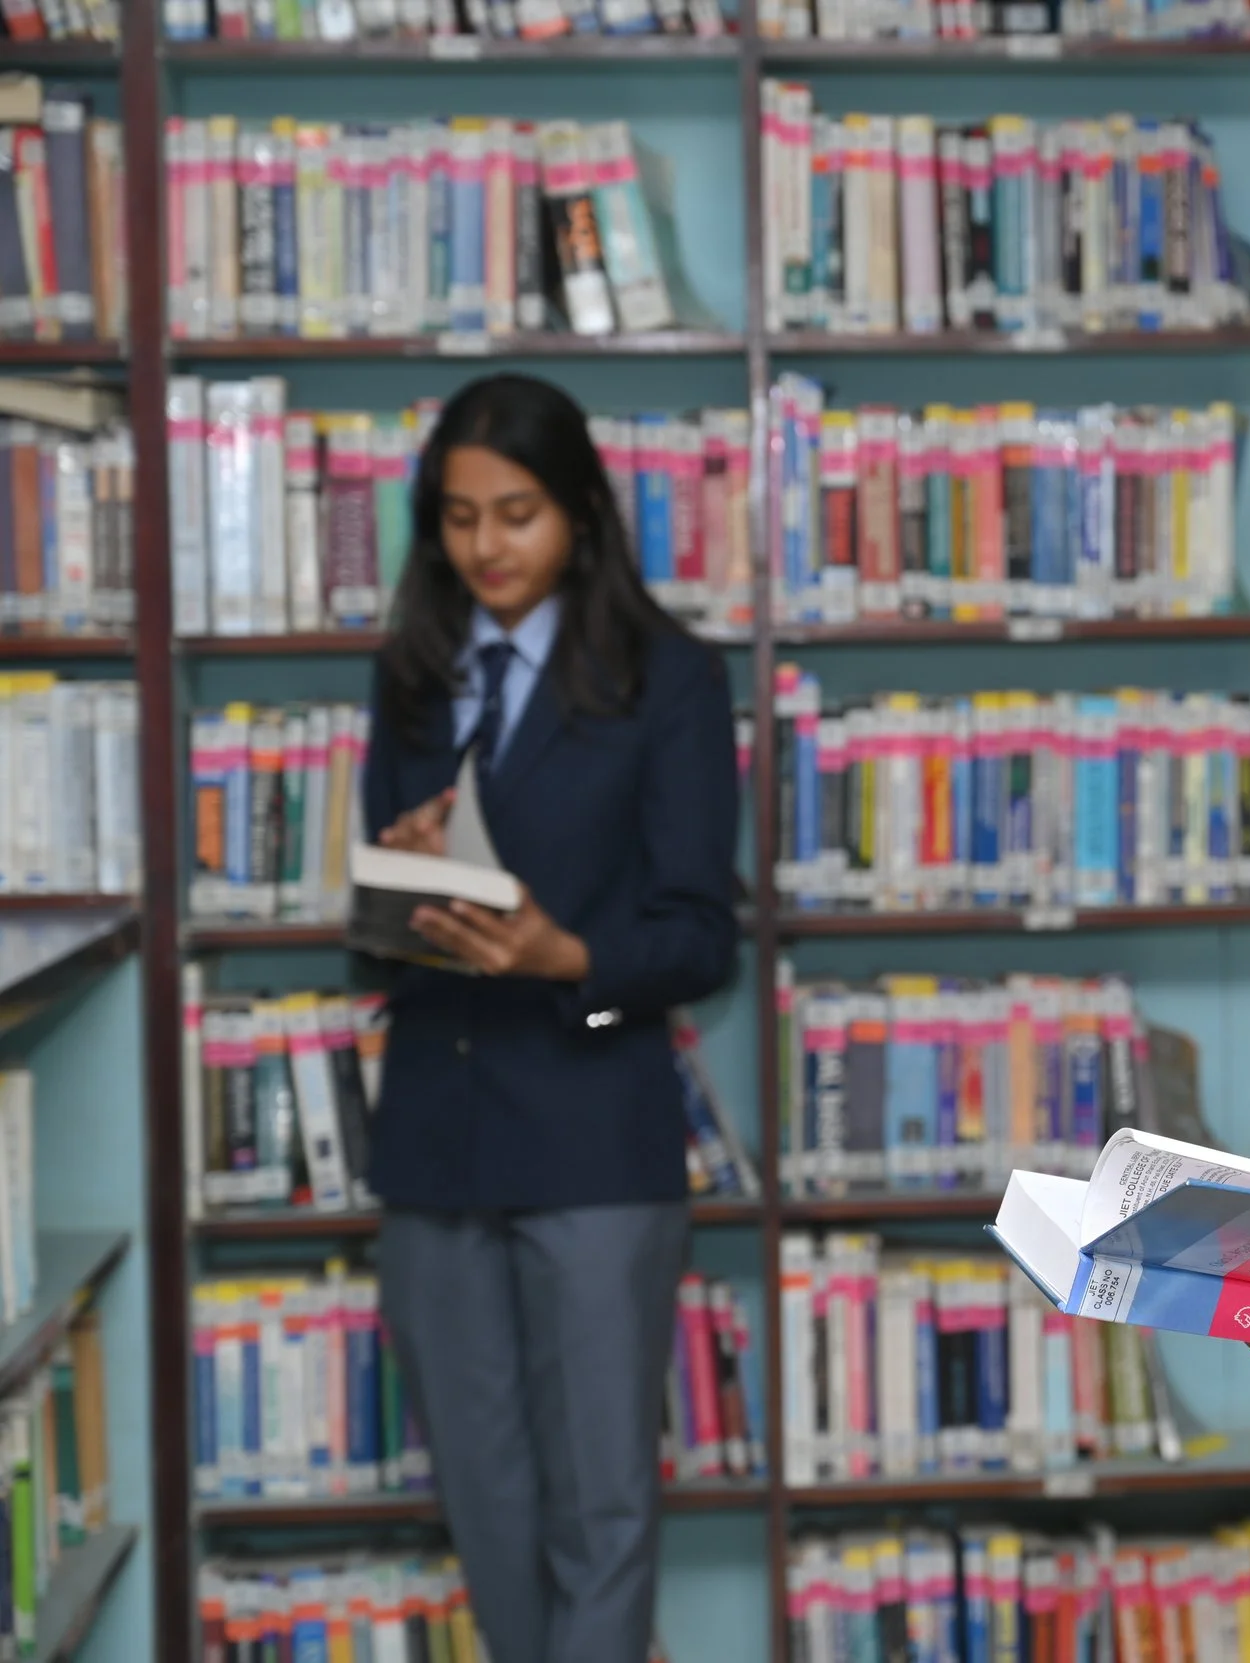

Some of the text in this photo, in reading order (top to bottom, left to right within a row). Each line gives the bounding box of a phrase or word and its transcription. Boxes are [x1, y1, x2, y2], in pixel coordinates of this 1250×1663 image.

[1119, 1198, 1131, 1219] JIET
[1125, 1162, 1147, 1197] COLLEGE
[1160, 1179, 1171, 1192] DUE
[1089, 1280, 1099, 1296] JIET
[1094, 1269, 1113, 1310] CLASS NO
[1105, 1276, 1120, 1306] 006.754
